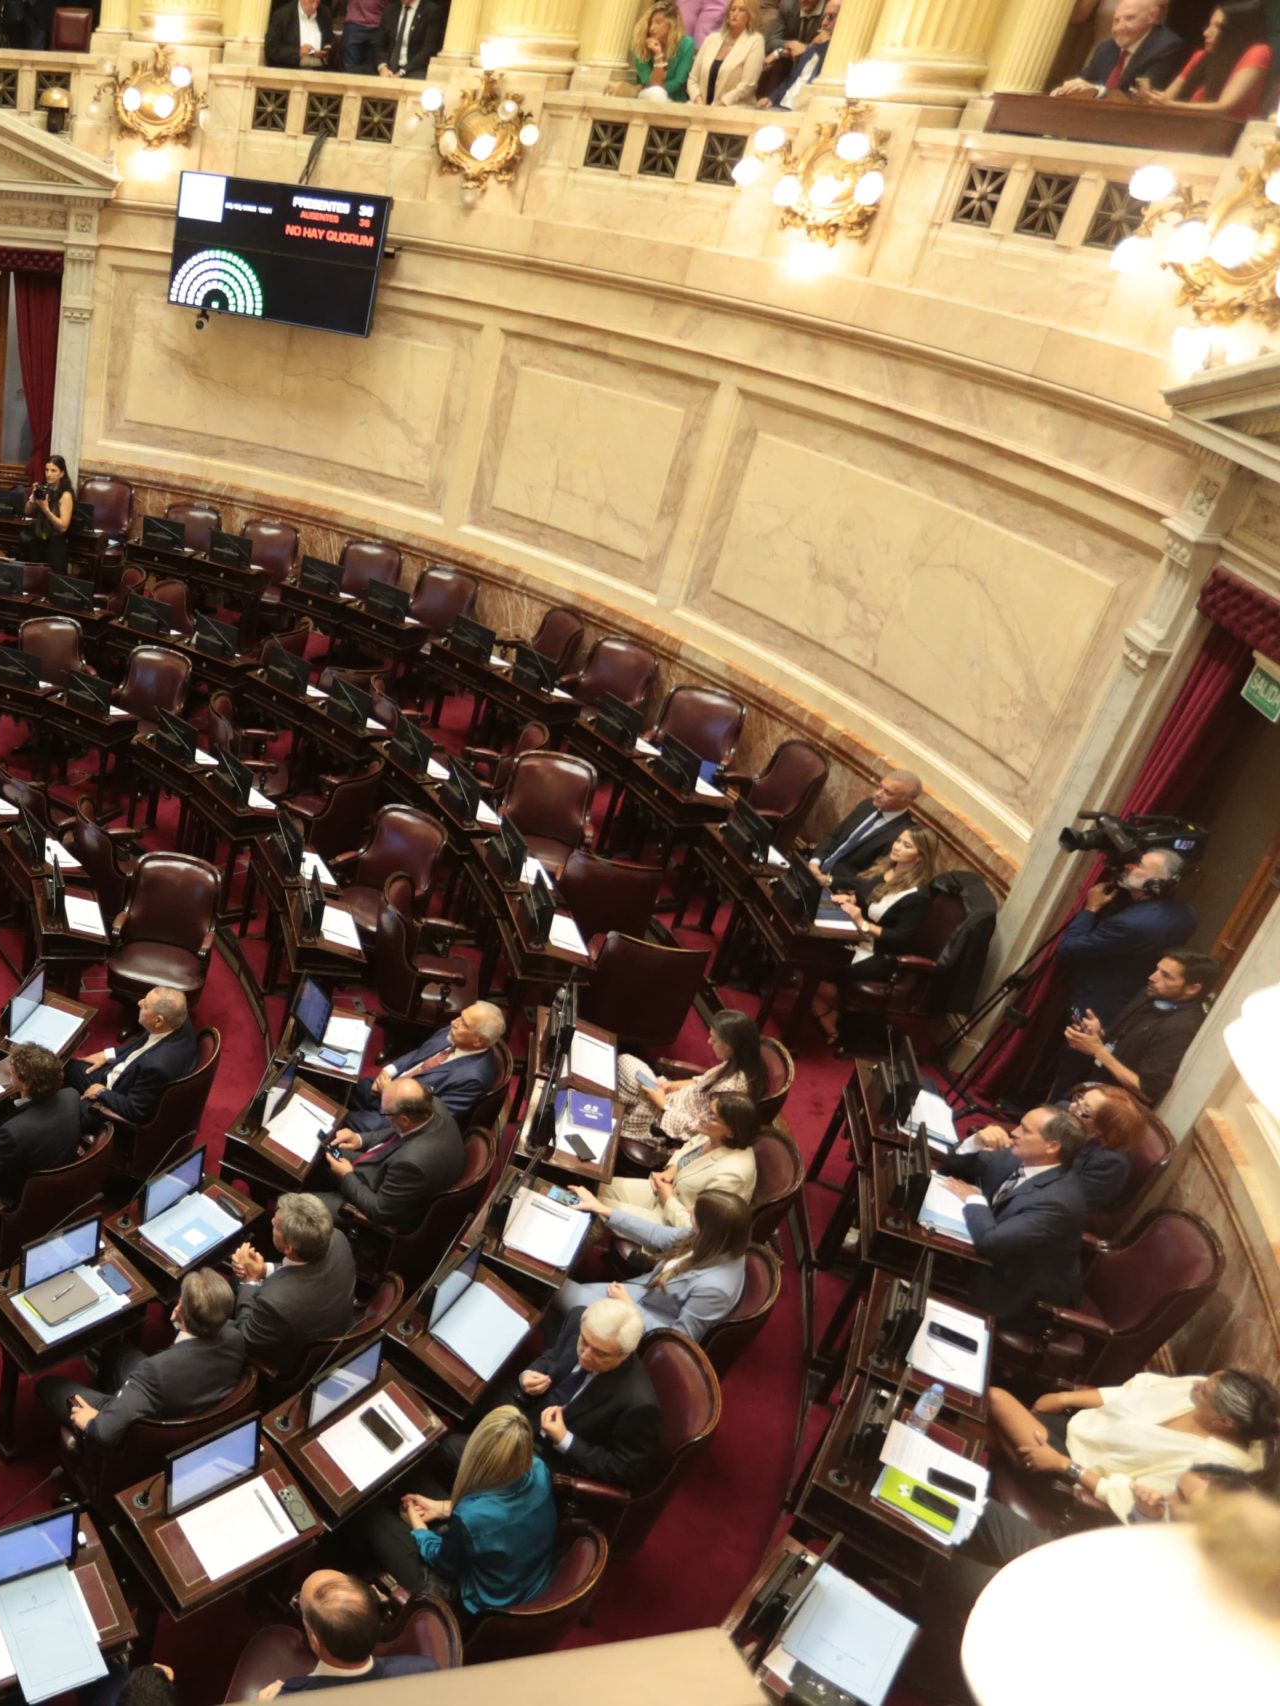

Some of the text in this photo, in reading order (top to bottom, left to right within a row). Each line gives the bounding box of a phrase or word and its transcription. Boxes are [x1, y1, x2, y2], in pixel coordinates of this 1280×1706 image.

[292, 196, 350, 214] PRESENTES
[300, 210, 340, 224] AUSENTES
[285, 224, 374, 247] NO HAY QUORUM
